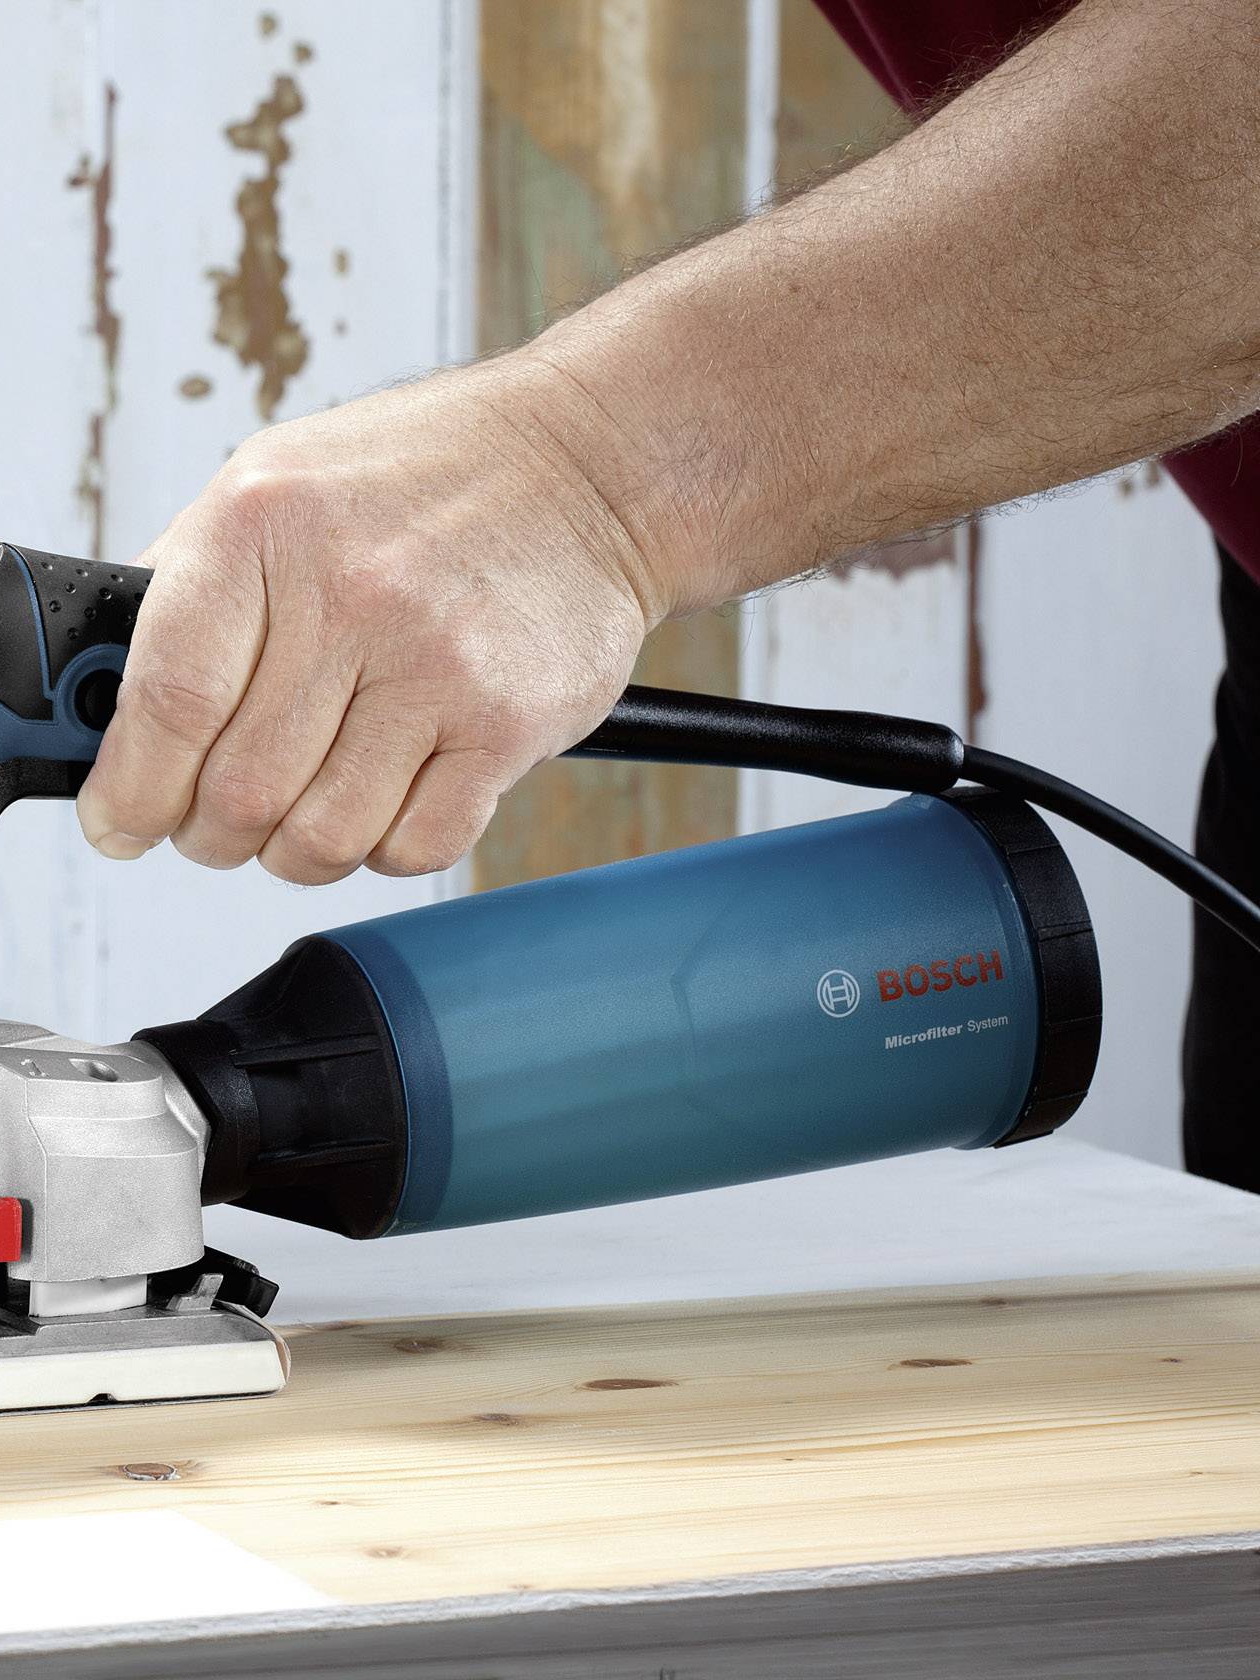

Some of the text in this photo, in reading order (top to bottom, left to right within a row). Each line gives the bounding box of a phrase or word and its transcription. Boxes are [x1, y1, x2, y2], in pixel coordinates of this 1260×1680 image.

[876, 949, 1005, 1002] BOSCH
[885, 1015, 1009, 1050] Microfilter System
